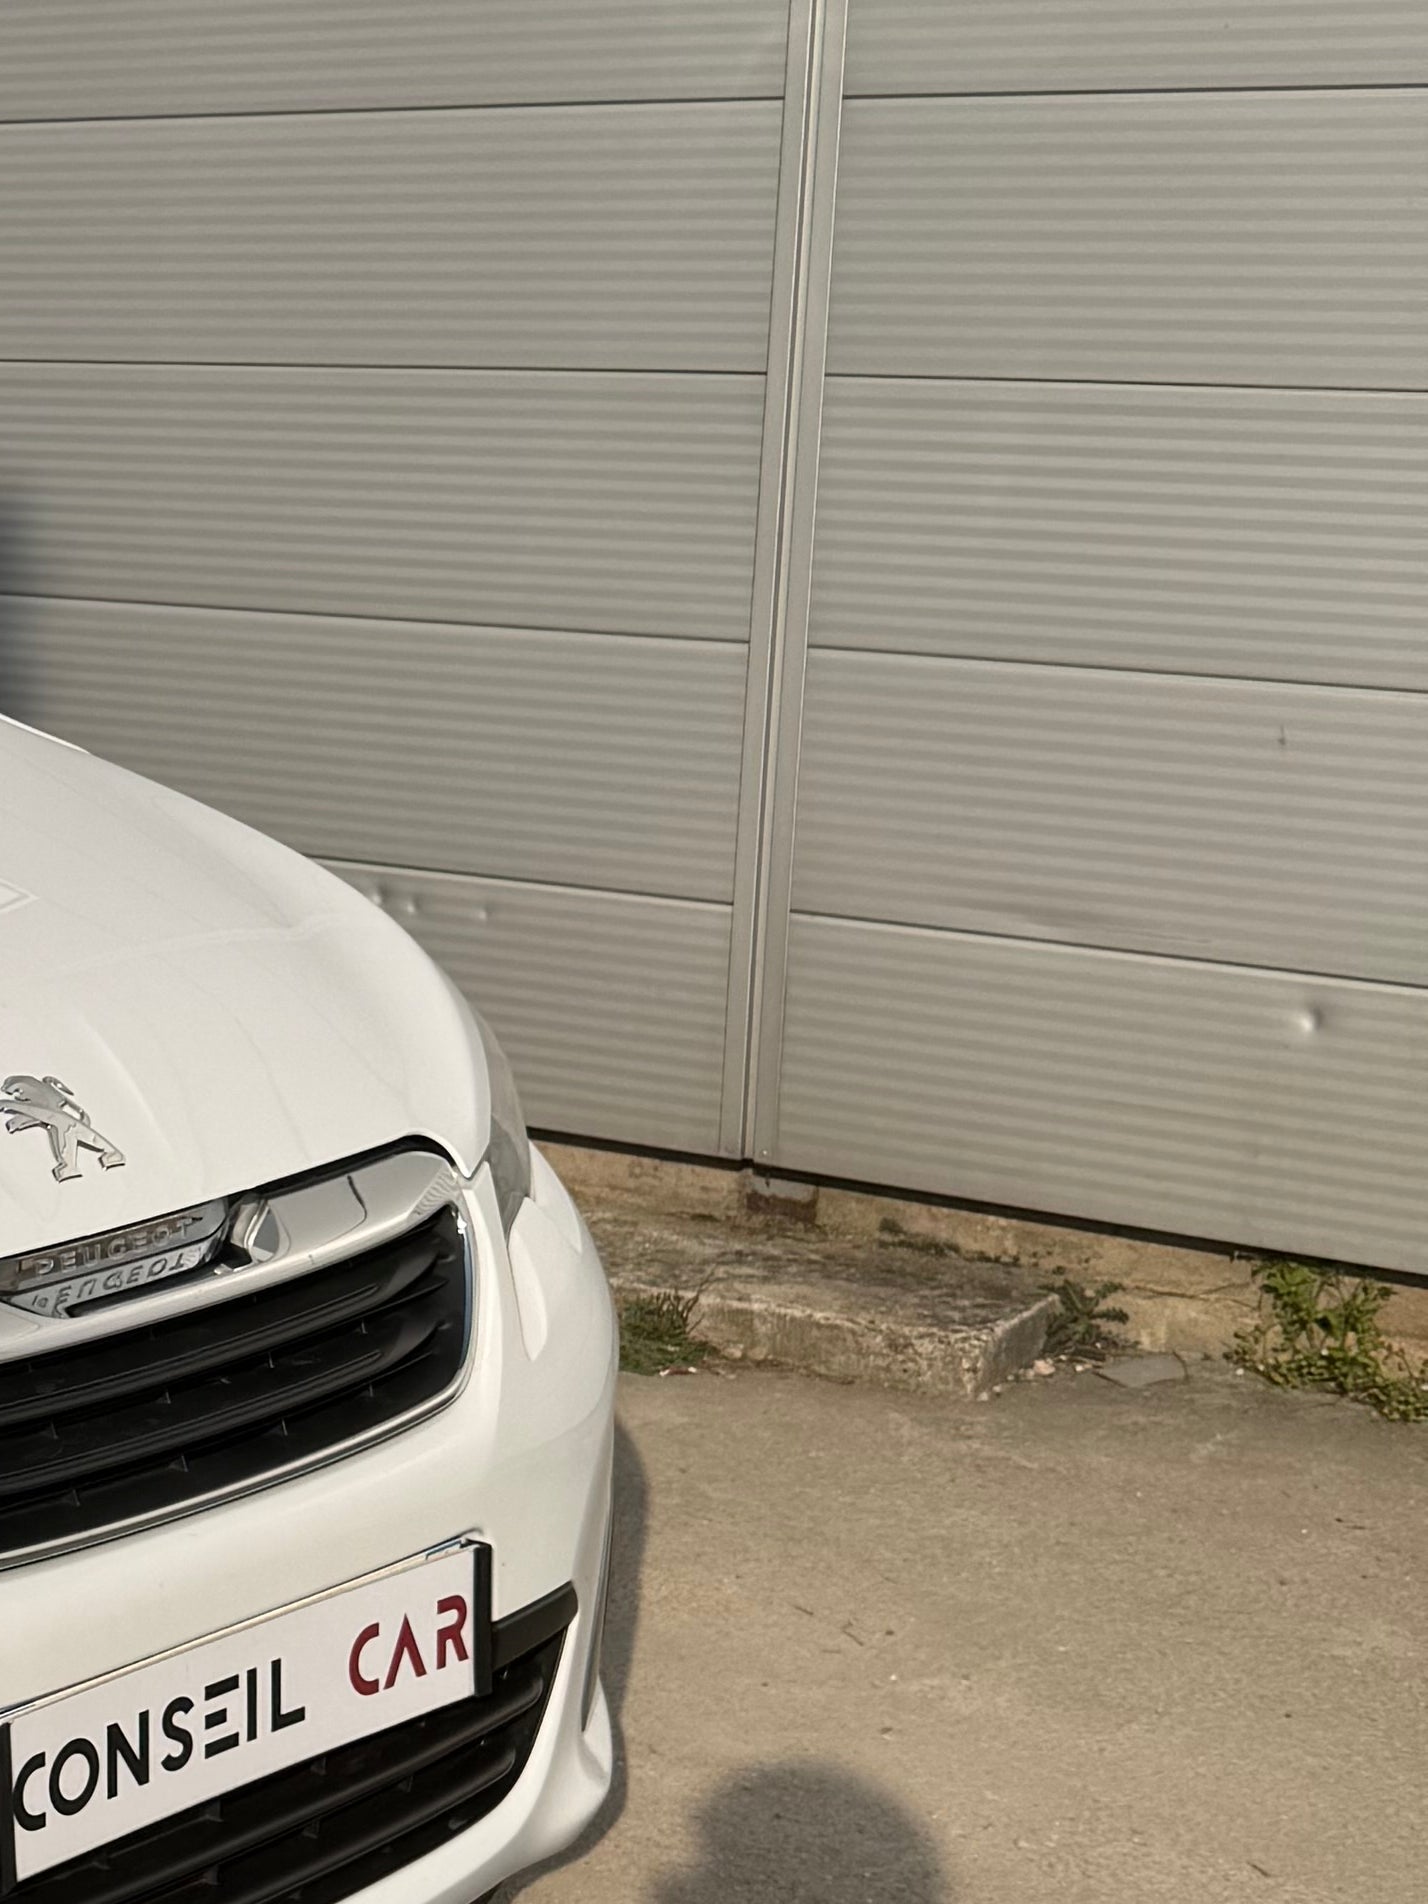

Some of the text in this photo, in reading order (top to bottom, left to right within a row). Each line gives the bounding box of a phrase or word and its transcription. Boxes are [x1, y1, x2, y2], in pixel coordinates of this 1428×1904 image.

[31, 1217, 196, 1275] PEUGEOT
[12, 1594, 470, 1832] CONSEIL CAR
